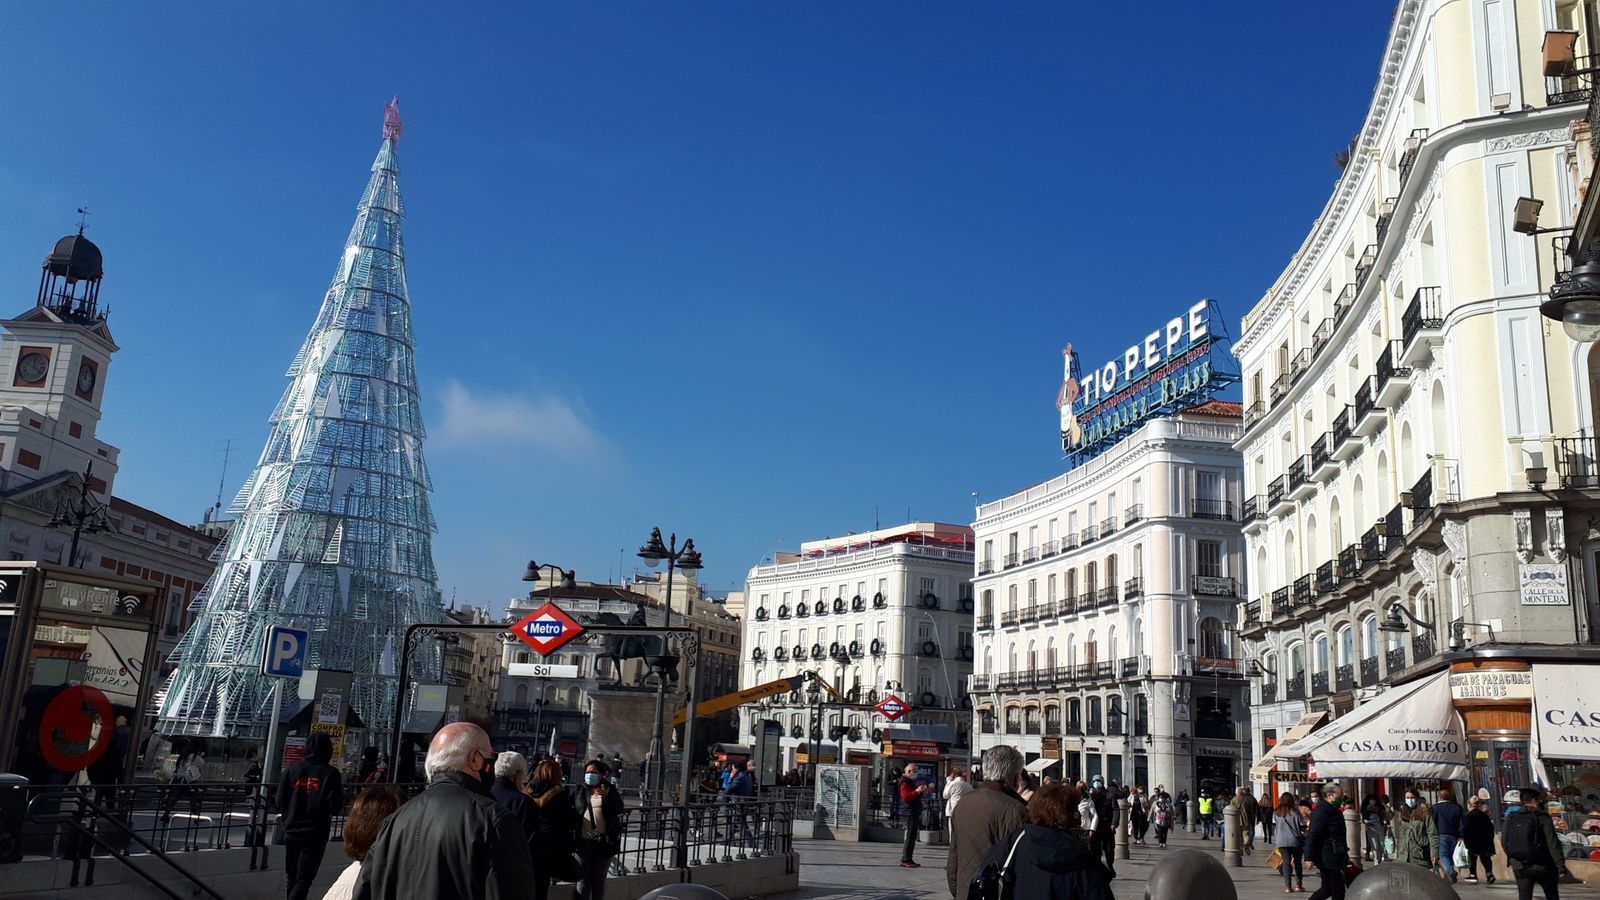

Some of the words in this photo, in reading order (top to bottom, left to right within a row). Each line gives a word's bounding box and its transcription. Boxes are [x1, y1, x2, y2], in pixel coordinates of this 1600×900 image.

[1081, 361, 1117, 405] TIO
[1125, 299, 1209, 381] PEPE
[1524, 595, 1566, 603] MONTERA
[530, 622, 560, 634] Metro
[534, 665, 552, 676] Sol
[1470, 674, 1481, 686] DE
[1482, 673, 1531, 686] PARAGUAS
[1460, 685, 1507, 698] ABANICOS
[883, 703, 900, 712] Metro
[311, 724, 343, 732] COMPRO
[1338, 740, 1385, 753] CASA
[1388, 744, 1402, 752] DE
[1404, 739, 1459, 754] DIEGO
[1275, 772, 1324, 783] CHAN
